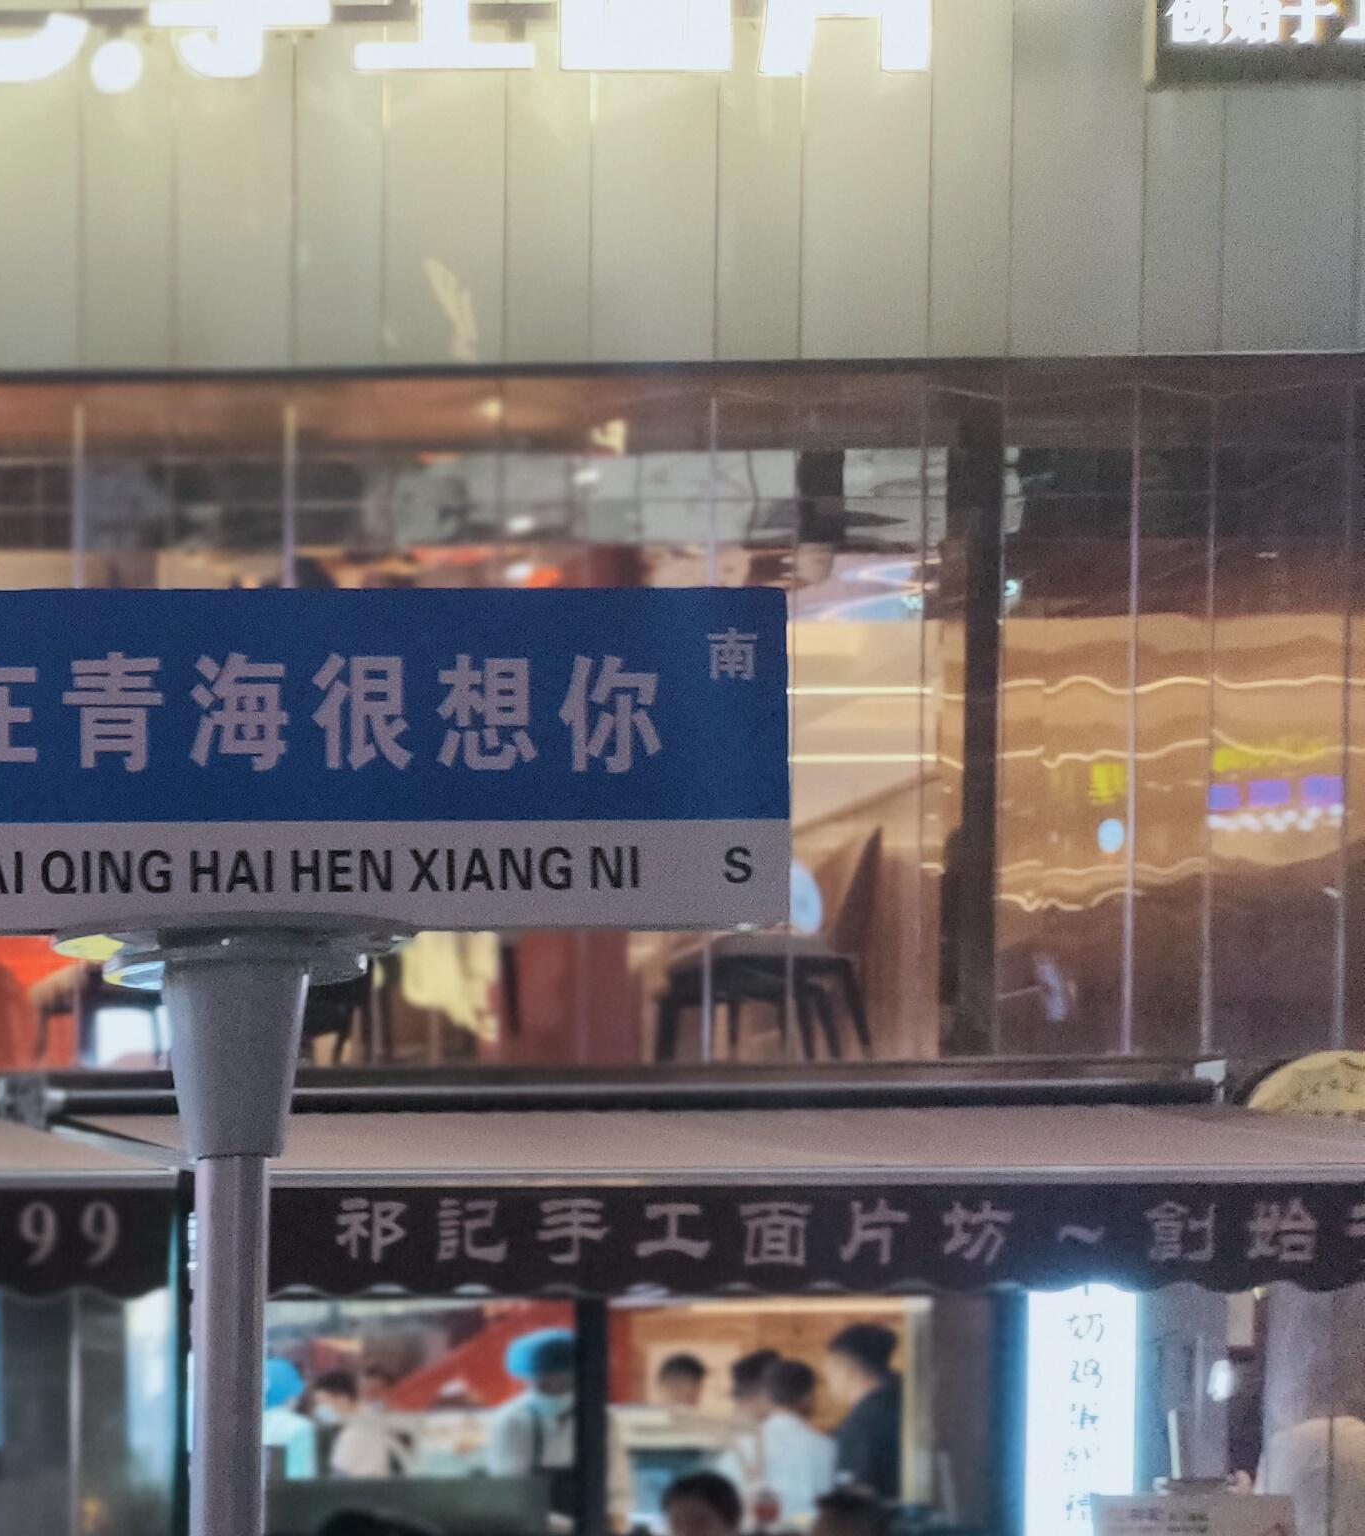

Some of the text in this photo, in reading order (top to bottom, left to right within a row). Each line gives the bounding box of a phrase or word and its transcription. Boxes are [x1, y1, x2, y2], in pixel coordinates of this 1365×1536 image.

[706, 628, 760, 681] 南
[41, 850, 171, 895] QING
[188, 849, 273, 894] HAI
[290, 848, 392, 893] HEN
[409, 846, 570, 892] XIANG
[590, 846, 639, 889] NI
[722, 846, 753, 885] S
